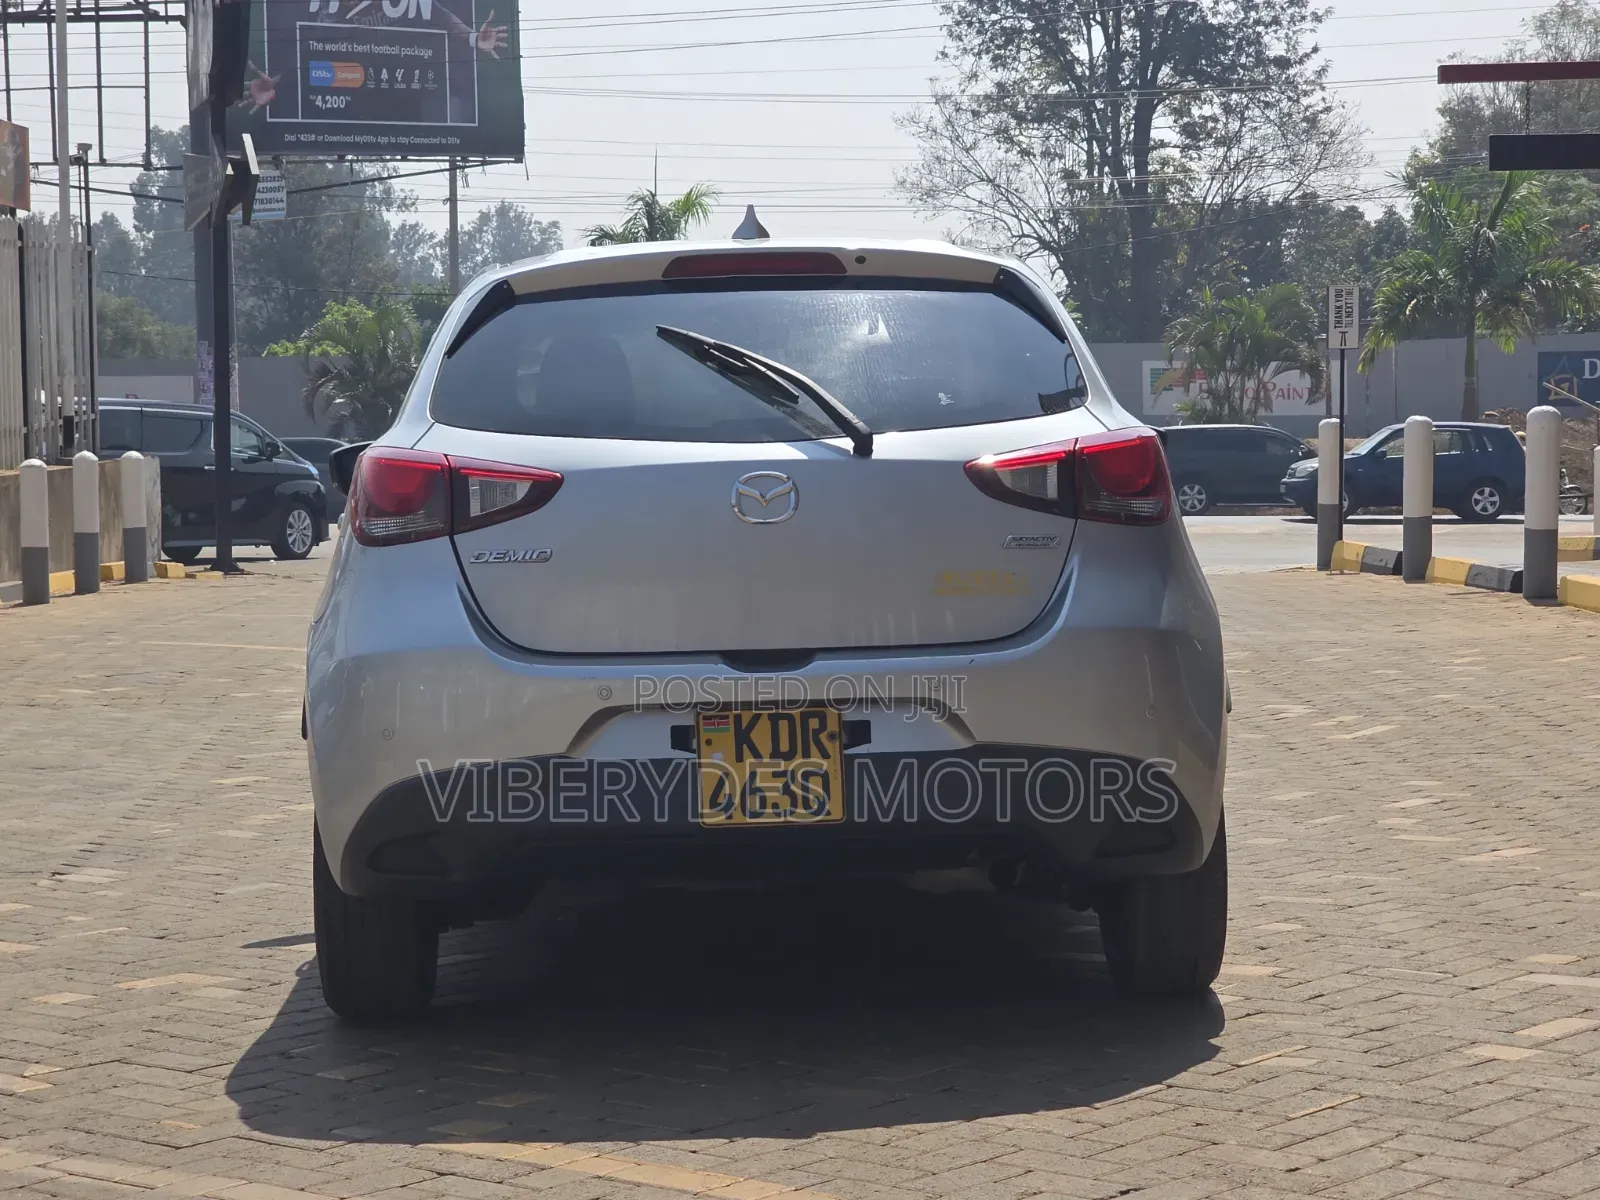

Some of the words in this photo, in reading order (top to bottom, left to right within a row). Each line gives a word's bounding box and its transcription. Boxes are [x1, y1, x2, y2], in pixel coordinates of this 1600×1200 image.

[309, 41, 323, 50] The
[325, 41, 352, 52] world's
[353, 43, 370, 53] best
[371, 43, 399, 54] football
[401, 45, 433, 58] package
[312, 69, 332, 78] DStv
[315, 95, 346, 109] 4,200
[284, 133, 296, 142] Dial
[324, 134, 353, 142] Download
[354, 134, 376, 144] MyDStv
[377, 136, 389, 145] App
[397, 136, 409, 145] stay
[410, 136, 440, 144] Connected
[1334, 288, 1344, 303] YOU
[1334, 304, 1344, 329] THANK
[1345, 302, 1354, 319] NEXT
[469, 547, 552, 564] DEMIO
[733, 711, 832, 764] KDR
